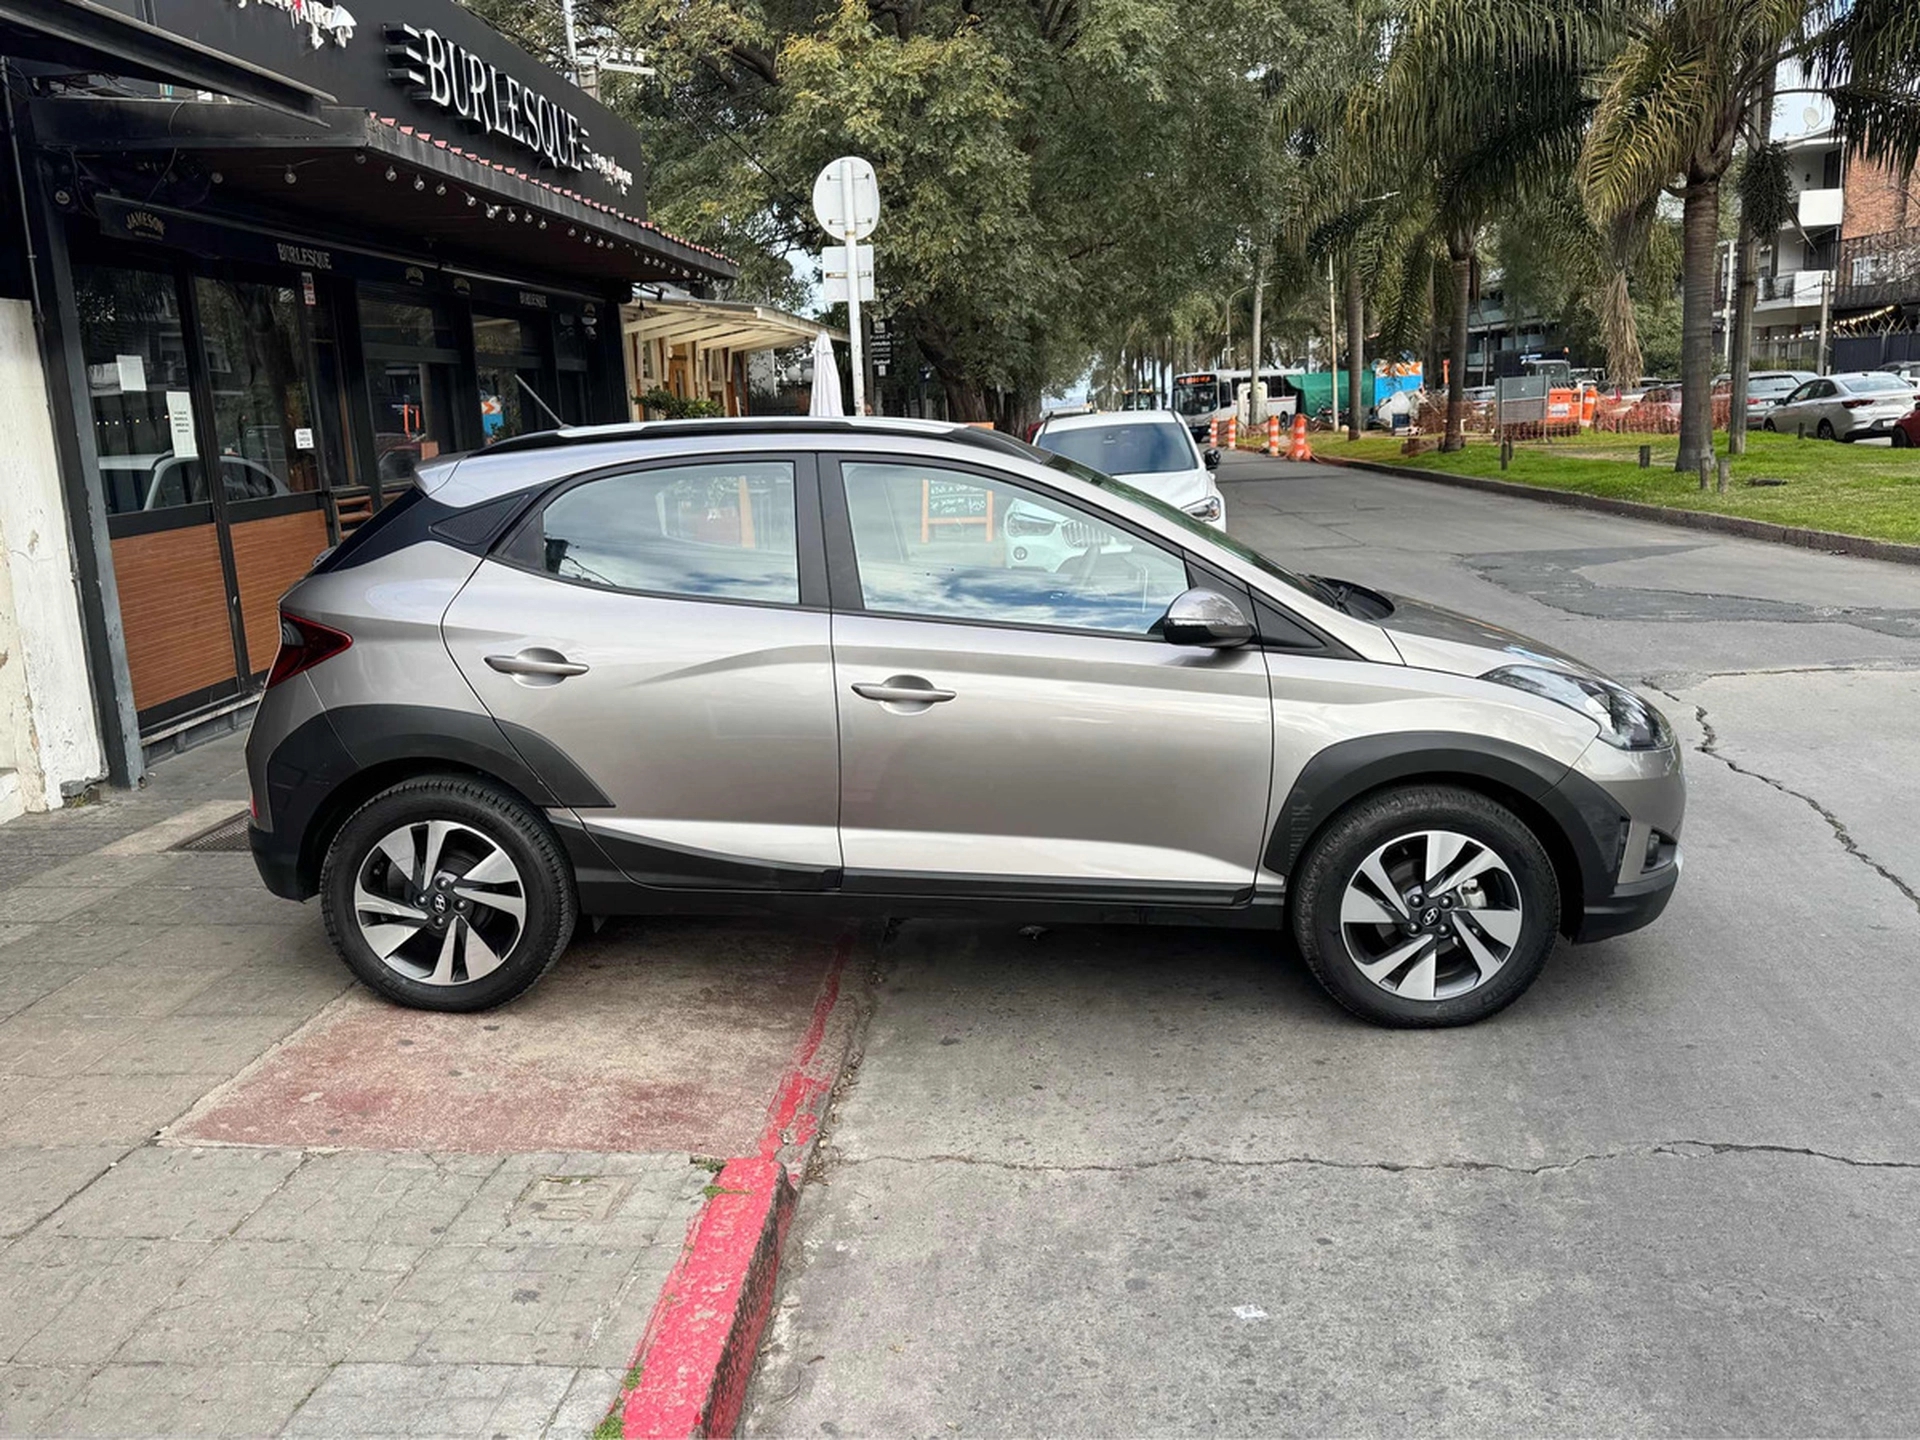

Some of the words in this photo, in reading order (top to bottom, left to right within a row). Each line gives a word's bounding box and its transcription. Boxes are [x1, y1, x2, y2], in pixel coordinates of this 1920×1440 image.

[424, 29, 583, 171] BURLESQUE
[126, 211, 165, 235] JAMESON
[276, 242, 332, 270] BURLESQUE
